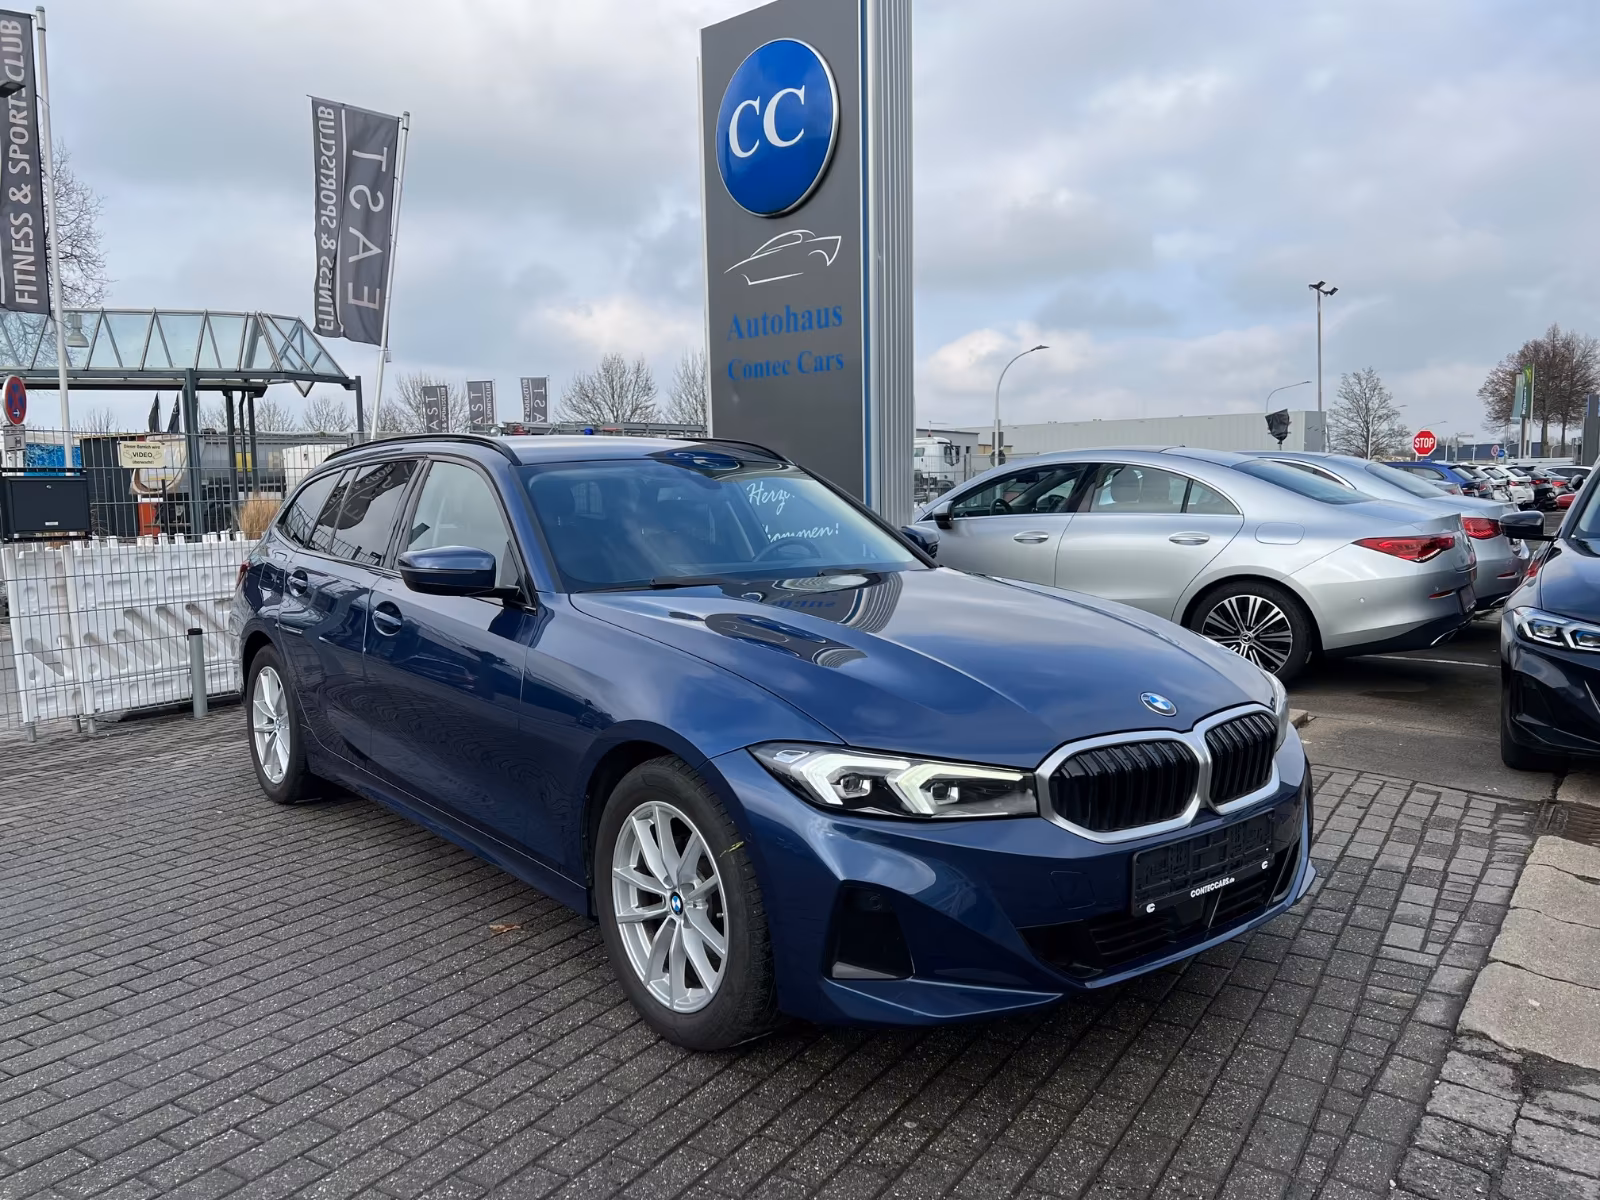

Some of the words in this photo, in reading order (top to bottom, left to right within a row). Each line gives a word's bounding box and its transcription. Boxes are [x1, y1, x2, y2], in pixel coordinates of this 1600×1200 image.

[729, 85, 805, 158] CC
[9, 184, 32, 205] &
[11, 212, 39, 304] FITNESS
[727, 304, 843, 341] Autohaus
[727, 358, 791, 381] Contec
[797, 350, 845, 375] Cars
[1414, 437, 1435, 448] STOP
